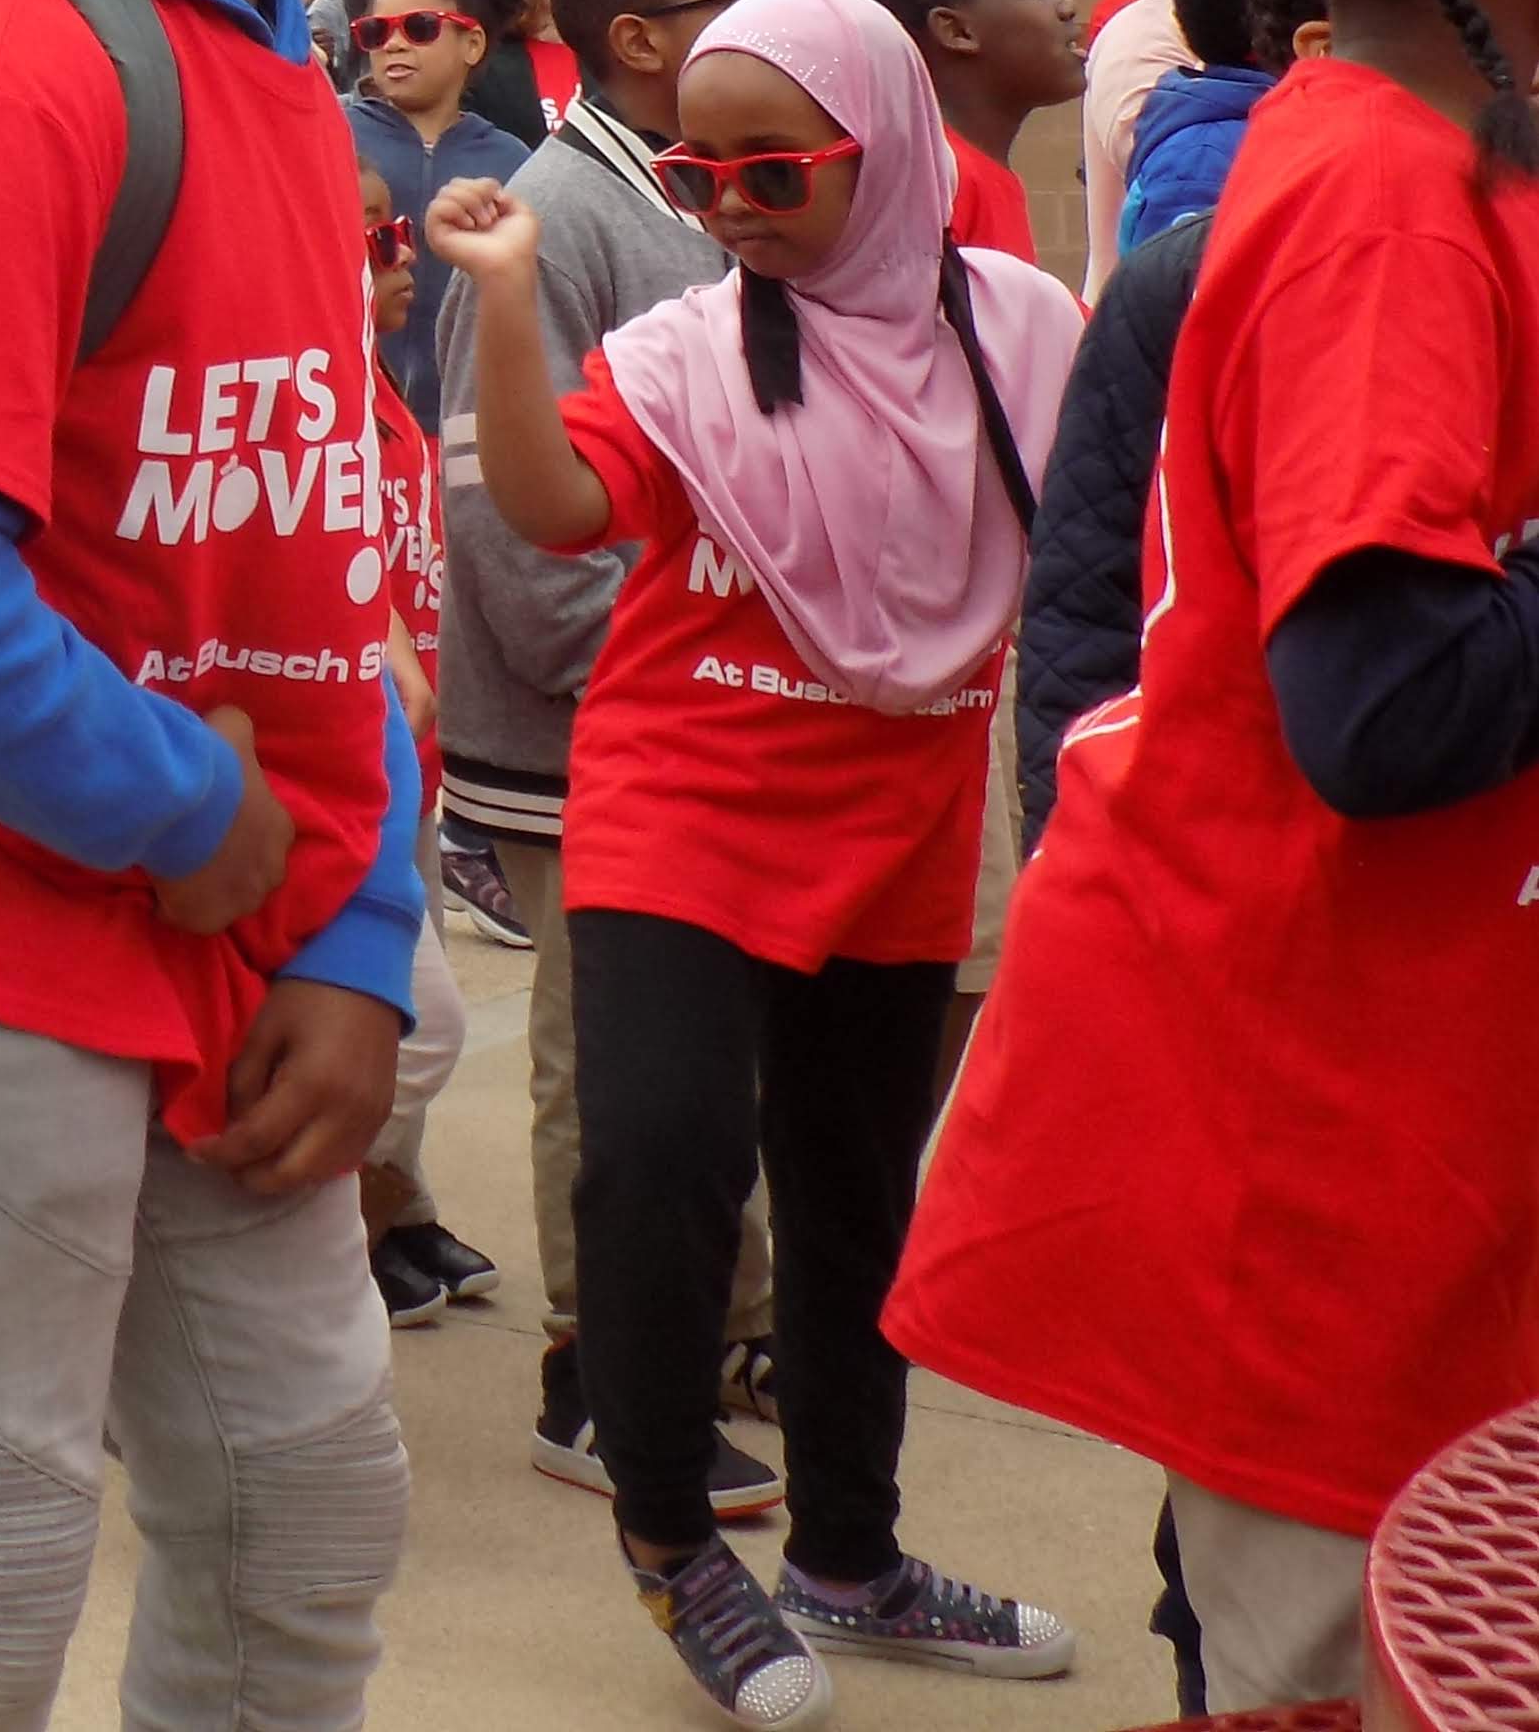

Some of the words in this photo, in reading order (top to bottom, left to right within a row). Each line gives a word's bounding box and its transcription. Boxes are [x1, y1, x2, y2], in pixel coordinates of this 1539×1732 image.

[137, 347, 337, 456] LETS
[134, 649, 193, 685] At
[194, 637, 349, 683] Busch
[692, 655, 744, 688] At
